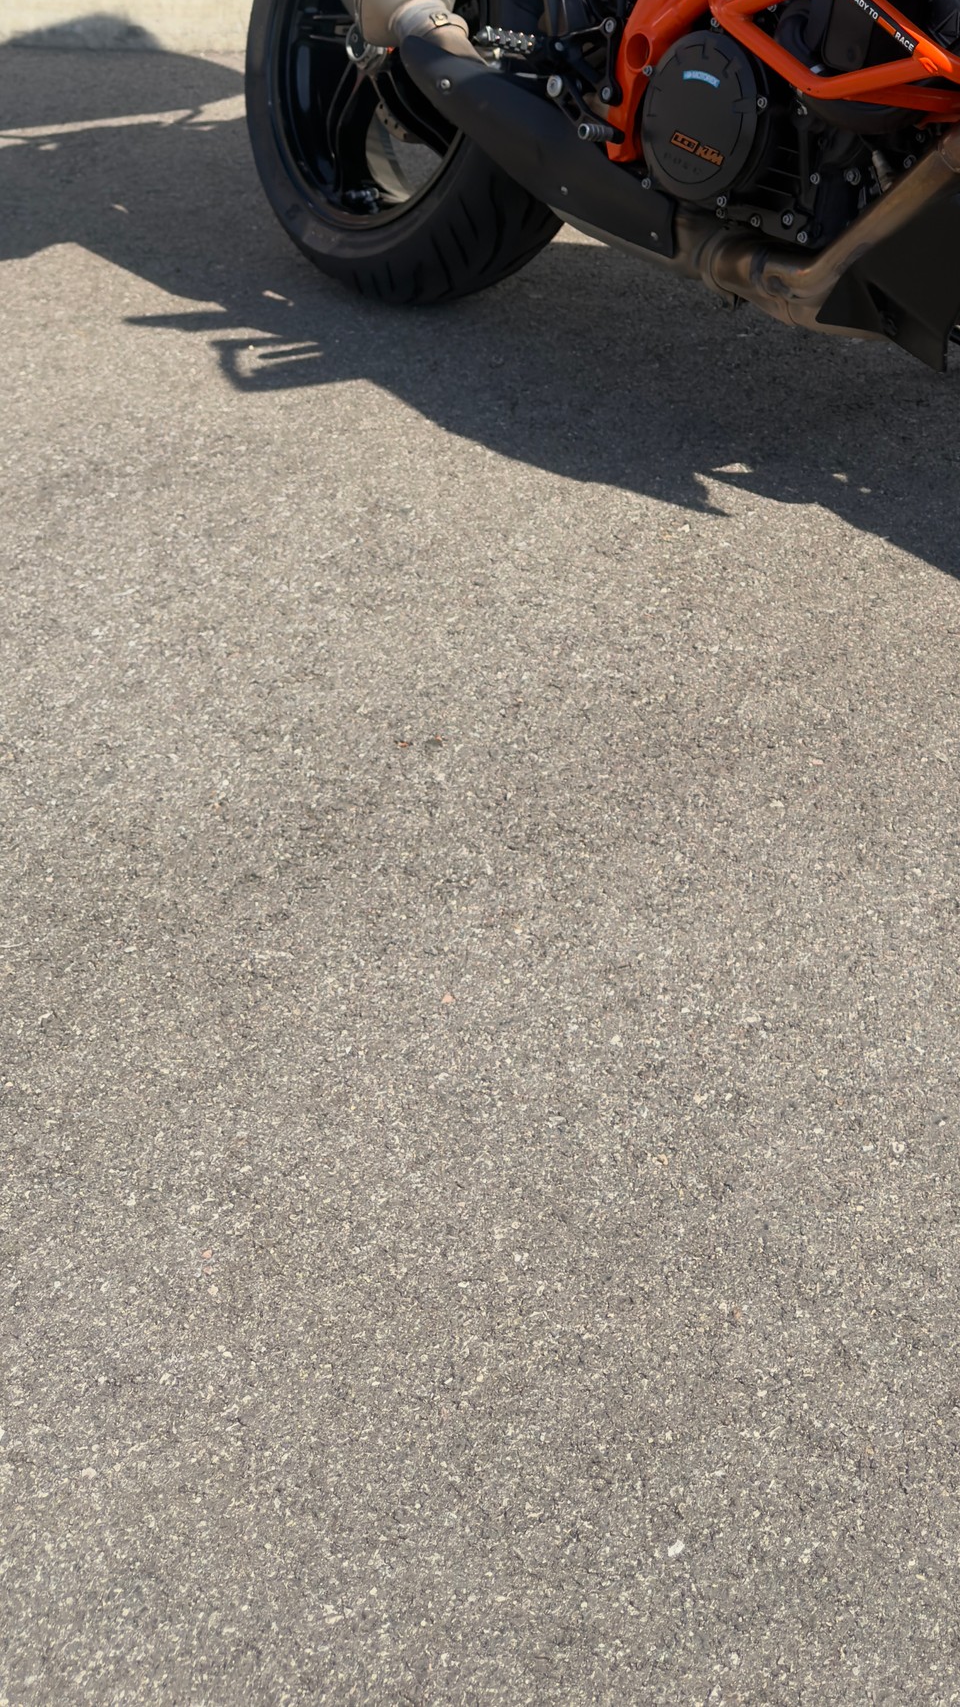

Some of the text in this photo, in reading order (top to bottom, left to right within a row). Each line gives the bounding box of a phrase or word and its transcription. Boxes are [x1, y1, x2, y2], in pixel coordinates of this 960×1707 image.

[868, 7, 879, 20] TO
[894, 31, 915, 52] RACE
[696, 145, 724, 166] KTM
